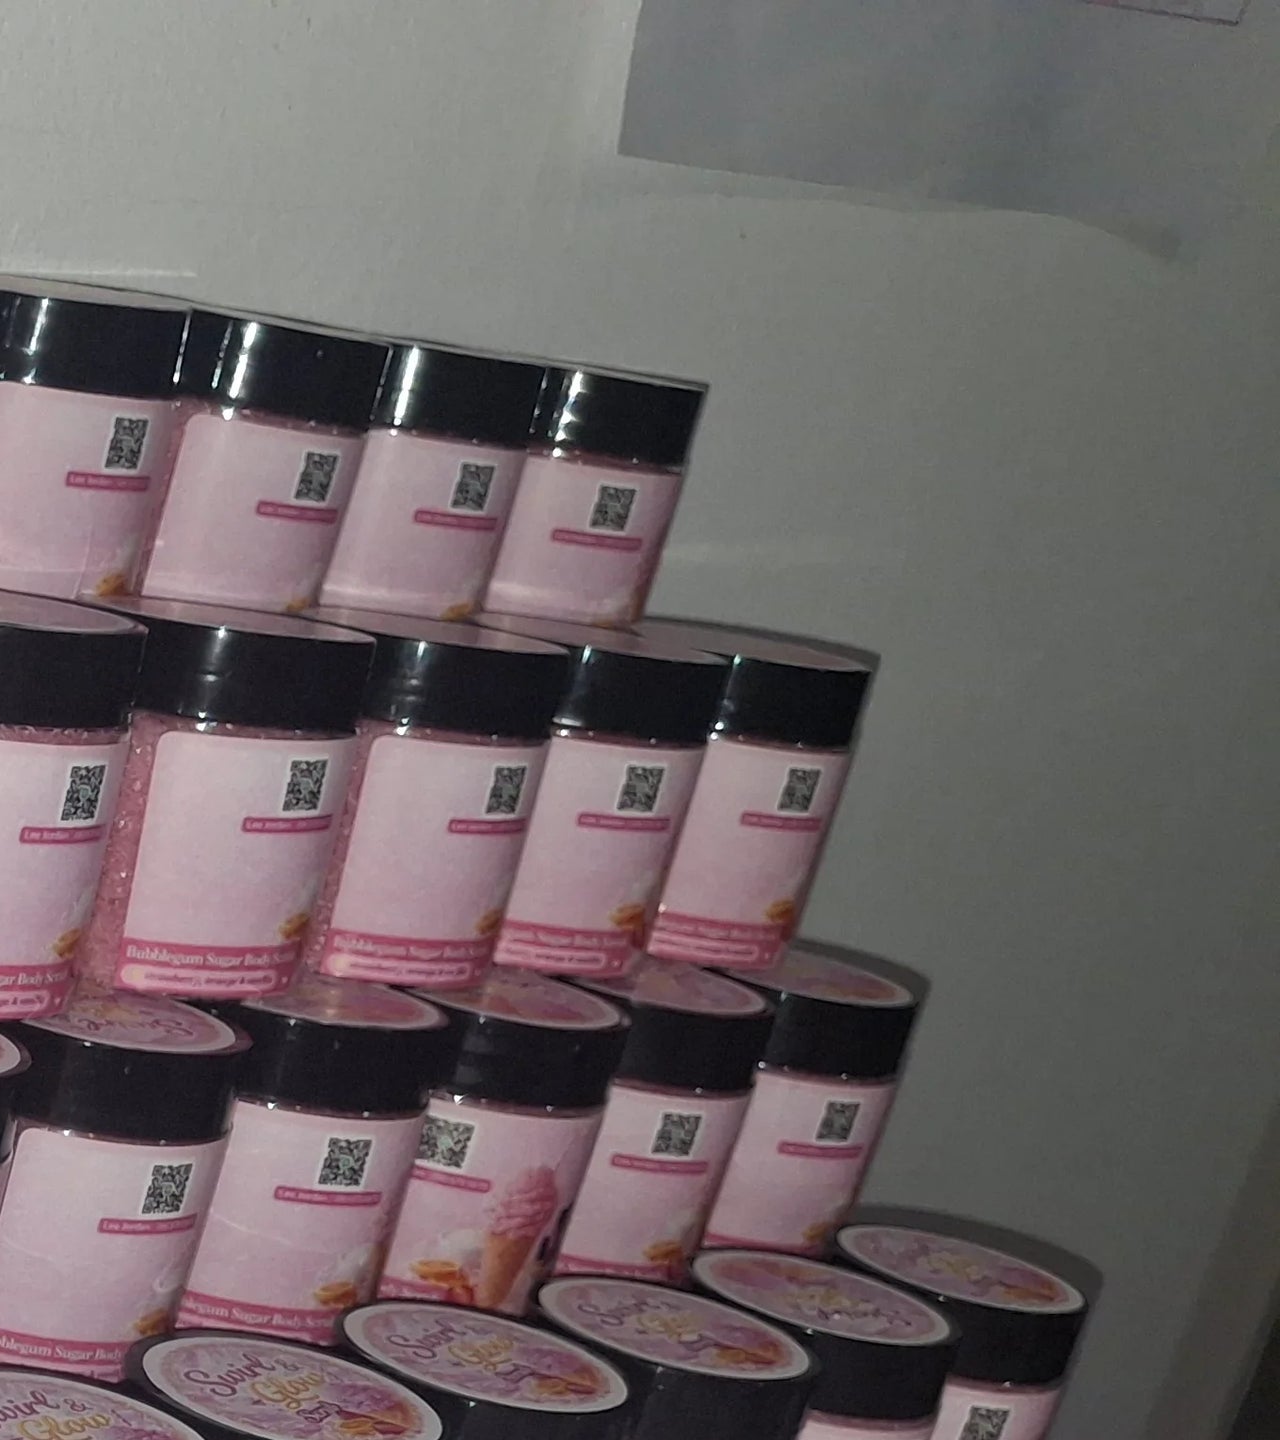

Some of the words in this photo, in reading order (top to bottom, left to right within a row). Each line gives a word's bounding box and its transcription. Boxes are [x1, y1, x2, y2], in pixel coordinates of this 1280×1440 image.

[125, 944, 204, 965] Bubblegum
[205, 952, 241, 966] Sugar
[54, 1345, 93, 1361] Sugar
[183, 1353, 277, 1398] Swirl
[248, 1371, 326, 1411] Glow
[62, 1397, 94, 1414] &
